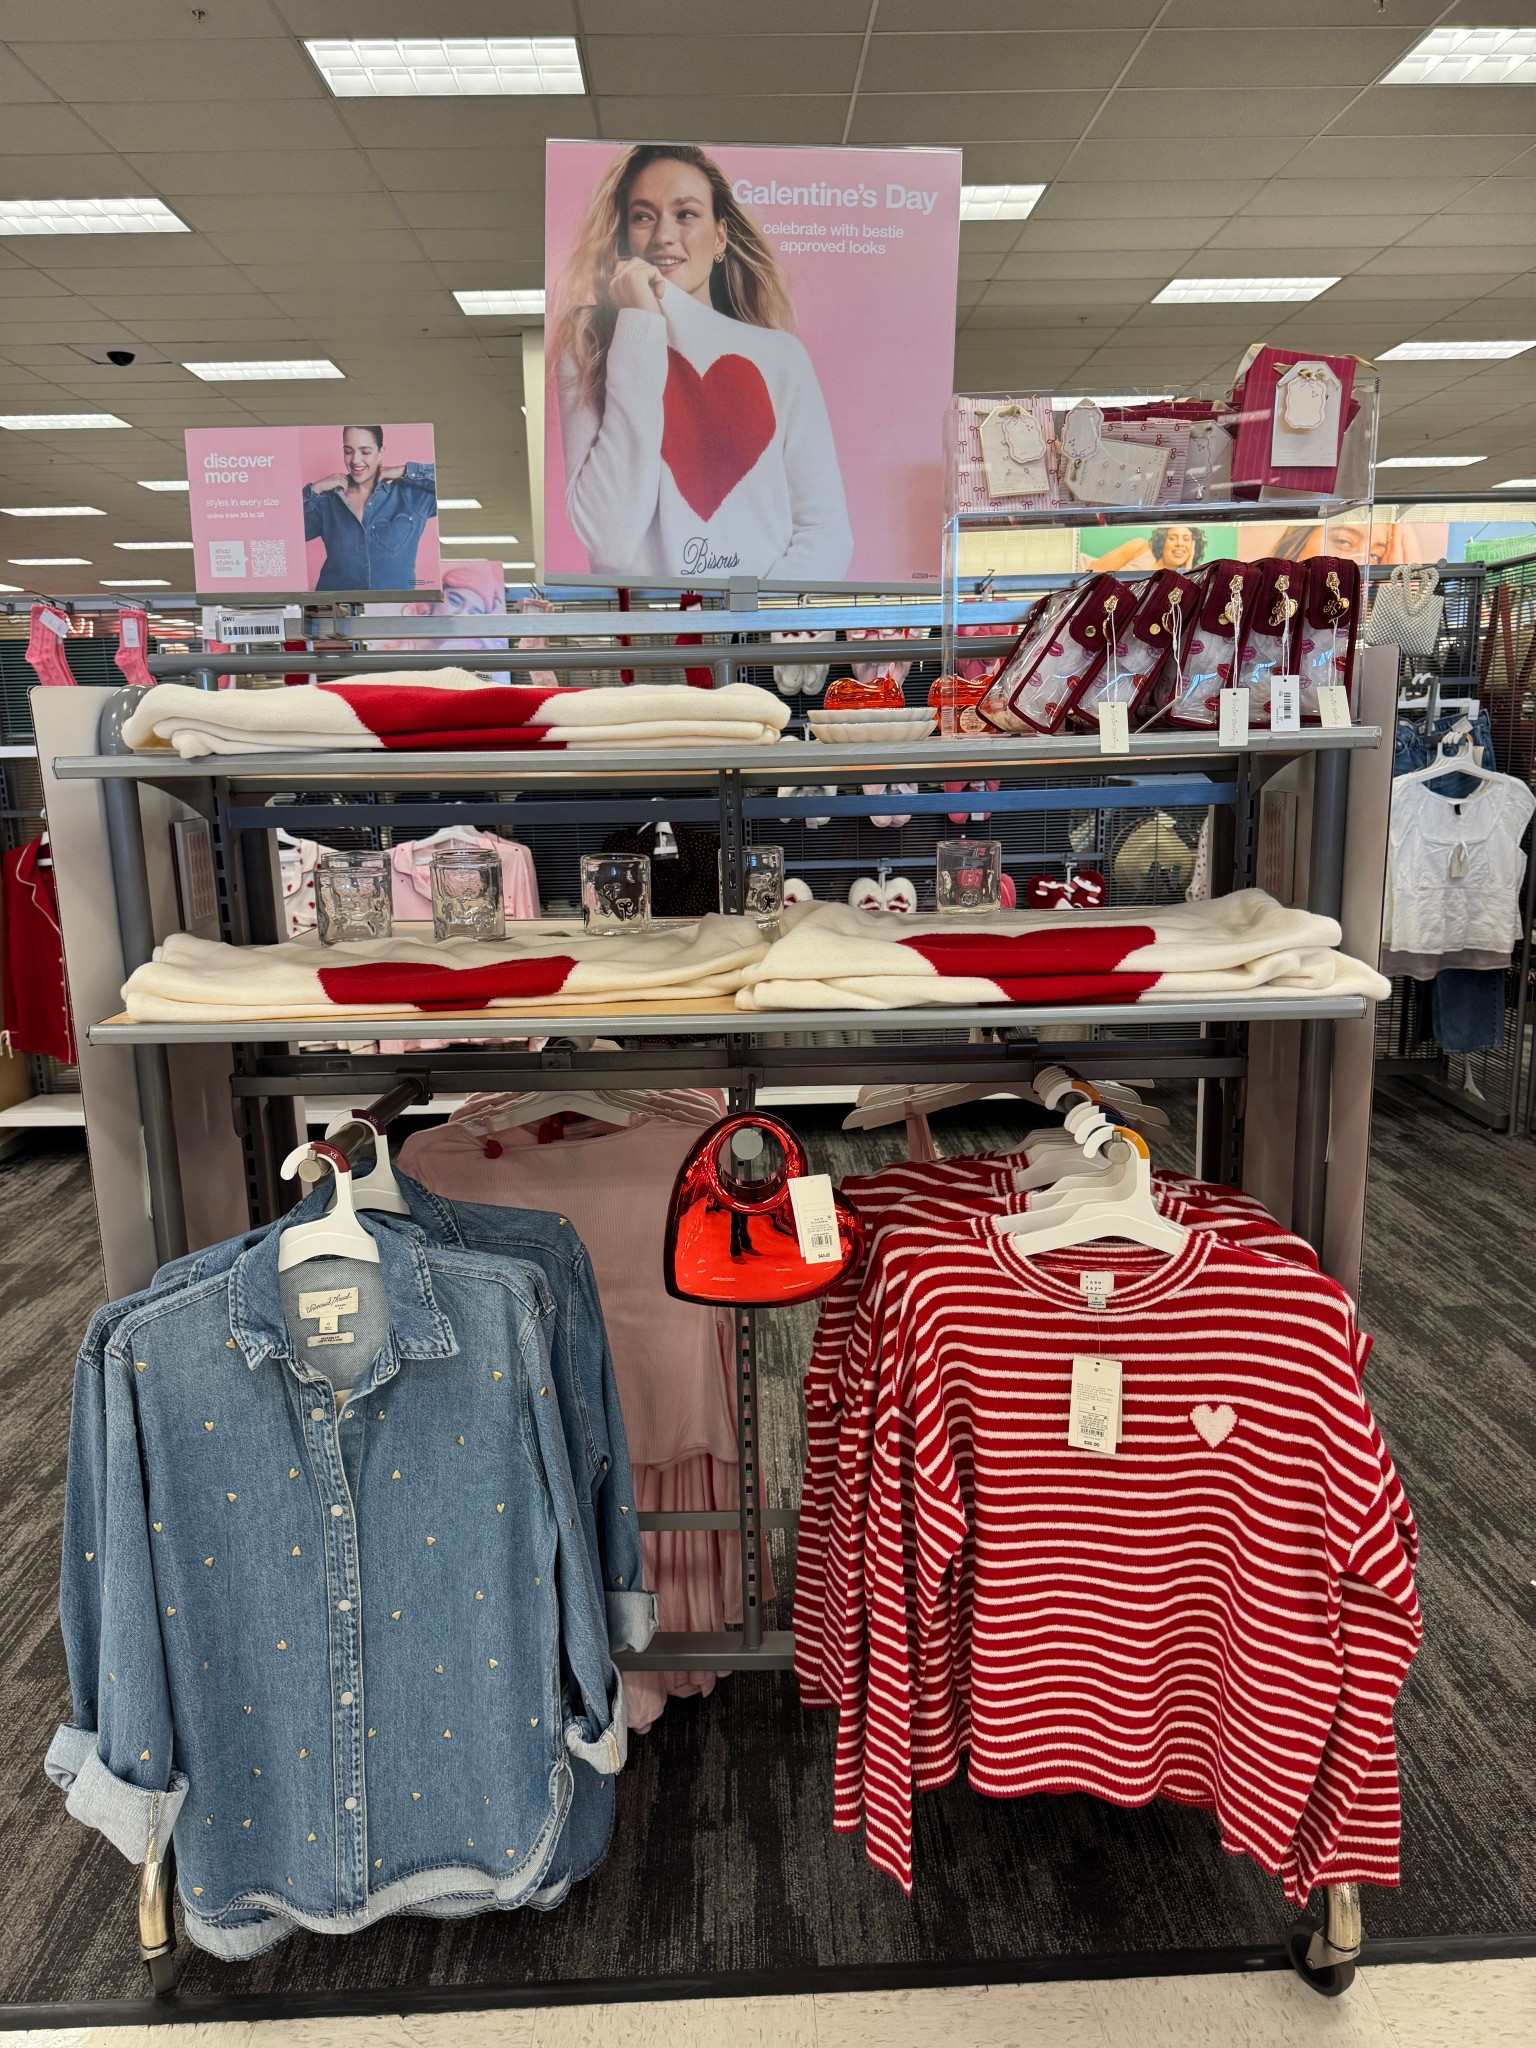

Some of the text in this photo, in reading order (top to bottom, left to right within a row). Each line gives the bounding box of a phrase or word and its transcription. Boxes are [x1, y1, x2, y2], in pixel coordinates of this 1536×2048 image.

[731, 179, 939, 216] Galentine's Day
[763, 221, 905, 239] celebrate with bestie
[780, 240, 886, 255] approved looks
[203, 453, 274, 469] discover
[204, 470, 249, 484] more
[206, 498, 279, 508] styles in every size
[680, 536, 740, 576] Bisous
[328, 1150, 339, 1160] XS
